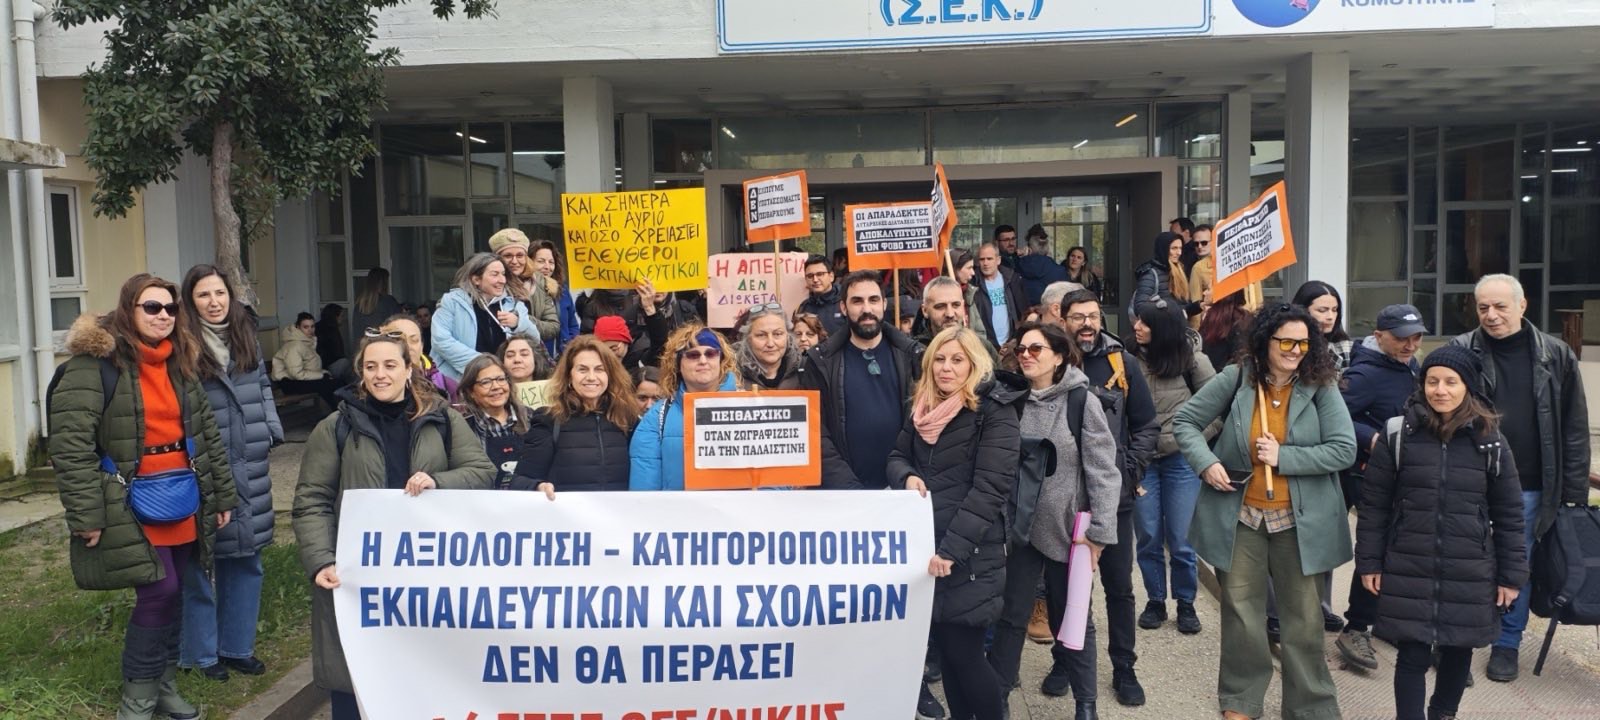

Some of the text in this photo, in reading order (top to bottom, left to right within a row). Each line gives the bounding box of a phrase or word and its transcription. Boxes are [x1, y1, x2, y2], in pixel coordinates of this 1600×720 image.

[566, 193, 670, 215] ΚΑΙ ΣΗΜΕΡΑ
[590, 211, 664, 229] ΚΑΙ ΑΥΡΙΟ
[855, 208, 928, 221] ΟΙ ΑΠΑΡΑΔΕΚΤΕΣ
[568, 223, 700, 244] ΚΑΙ ΟΣΟ ΧΡΕΙΑΣΤΕΙ
[859, 228, 928, 240] ΑΠΟΚΑΛΥΠΤΟΥΝ
[574, 246, 678, 263] ΕΛΕΥΘΕΡΟΙ
[861, 240, 928, 252] ΤΟΝ ΦΟΒΟ ΤΟΥΣ
[1220, 241, 1236, 257] ΟΤΑΝ
[1221, 255, 1232, 267] ΓΙΑ
[1232, 249, 1242, 261] ΤΗ
[583, 261, 699, 284] ΕΚΠΑΙΔΕΥΤΙΚΟΙ
[716, 259, 729, 277] Η
[737, 278, 766, 291] ΔΕΝ
[711, 409, 791, 421] ΠΕΙΘΑΡΧΙΚΟ
[704, 428, 799, 441] ΟΤΑΝ ΖΩΓΡΑΦΙΖΕΙΣ
[698, 443, 805, 456] ΓΙΑ ΤΗΝ ΠΑΛΑΙΣΤΙΝΗ
[361, 531, 382, 566] Η
[393, 531, 591, 567] ΑΞΙΟΛΟΓΗΣΗ
[632, 531, 907, 566] ΚΑΤΗΓΟΡΙΟΠΟΙΗΣΗ
[360, 583, 908, 629] ΕΚΠΑΙΔΕΥΤΙΚΩΝ ΚΑΙ ΣΧΟΛΕΙΩΝ
[482, 642, 795, 684] ΔΕΝ ΘΑ ΠΕΡΑΣΕΙ
